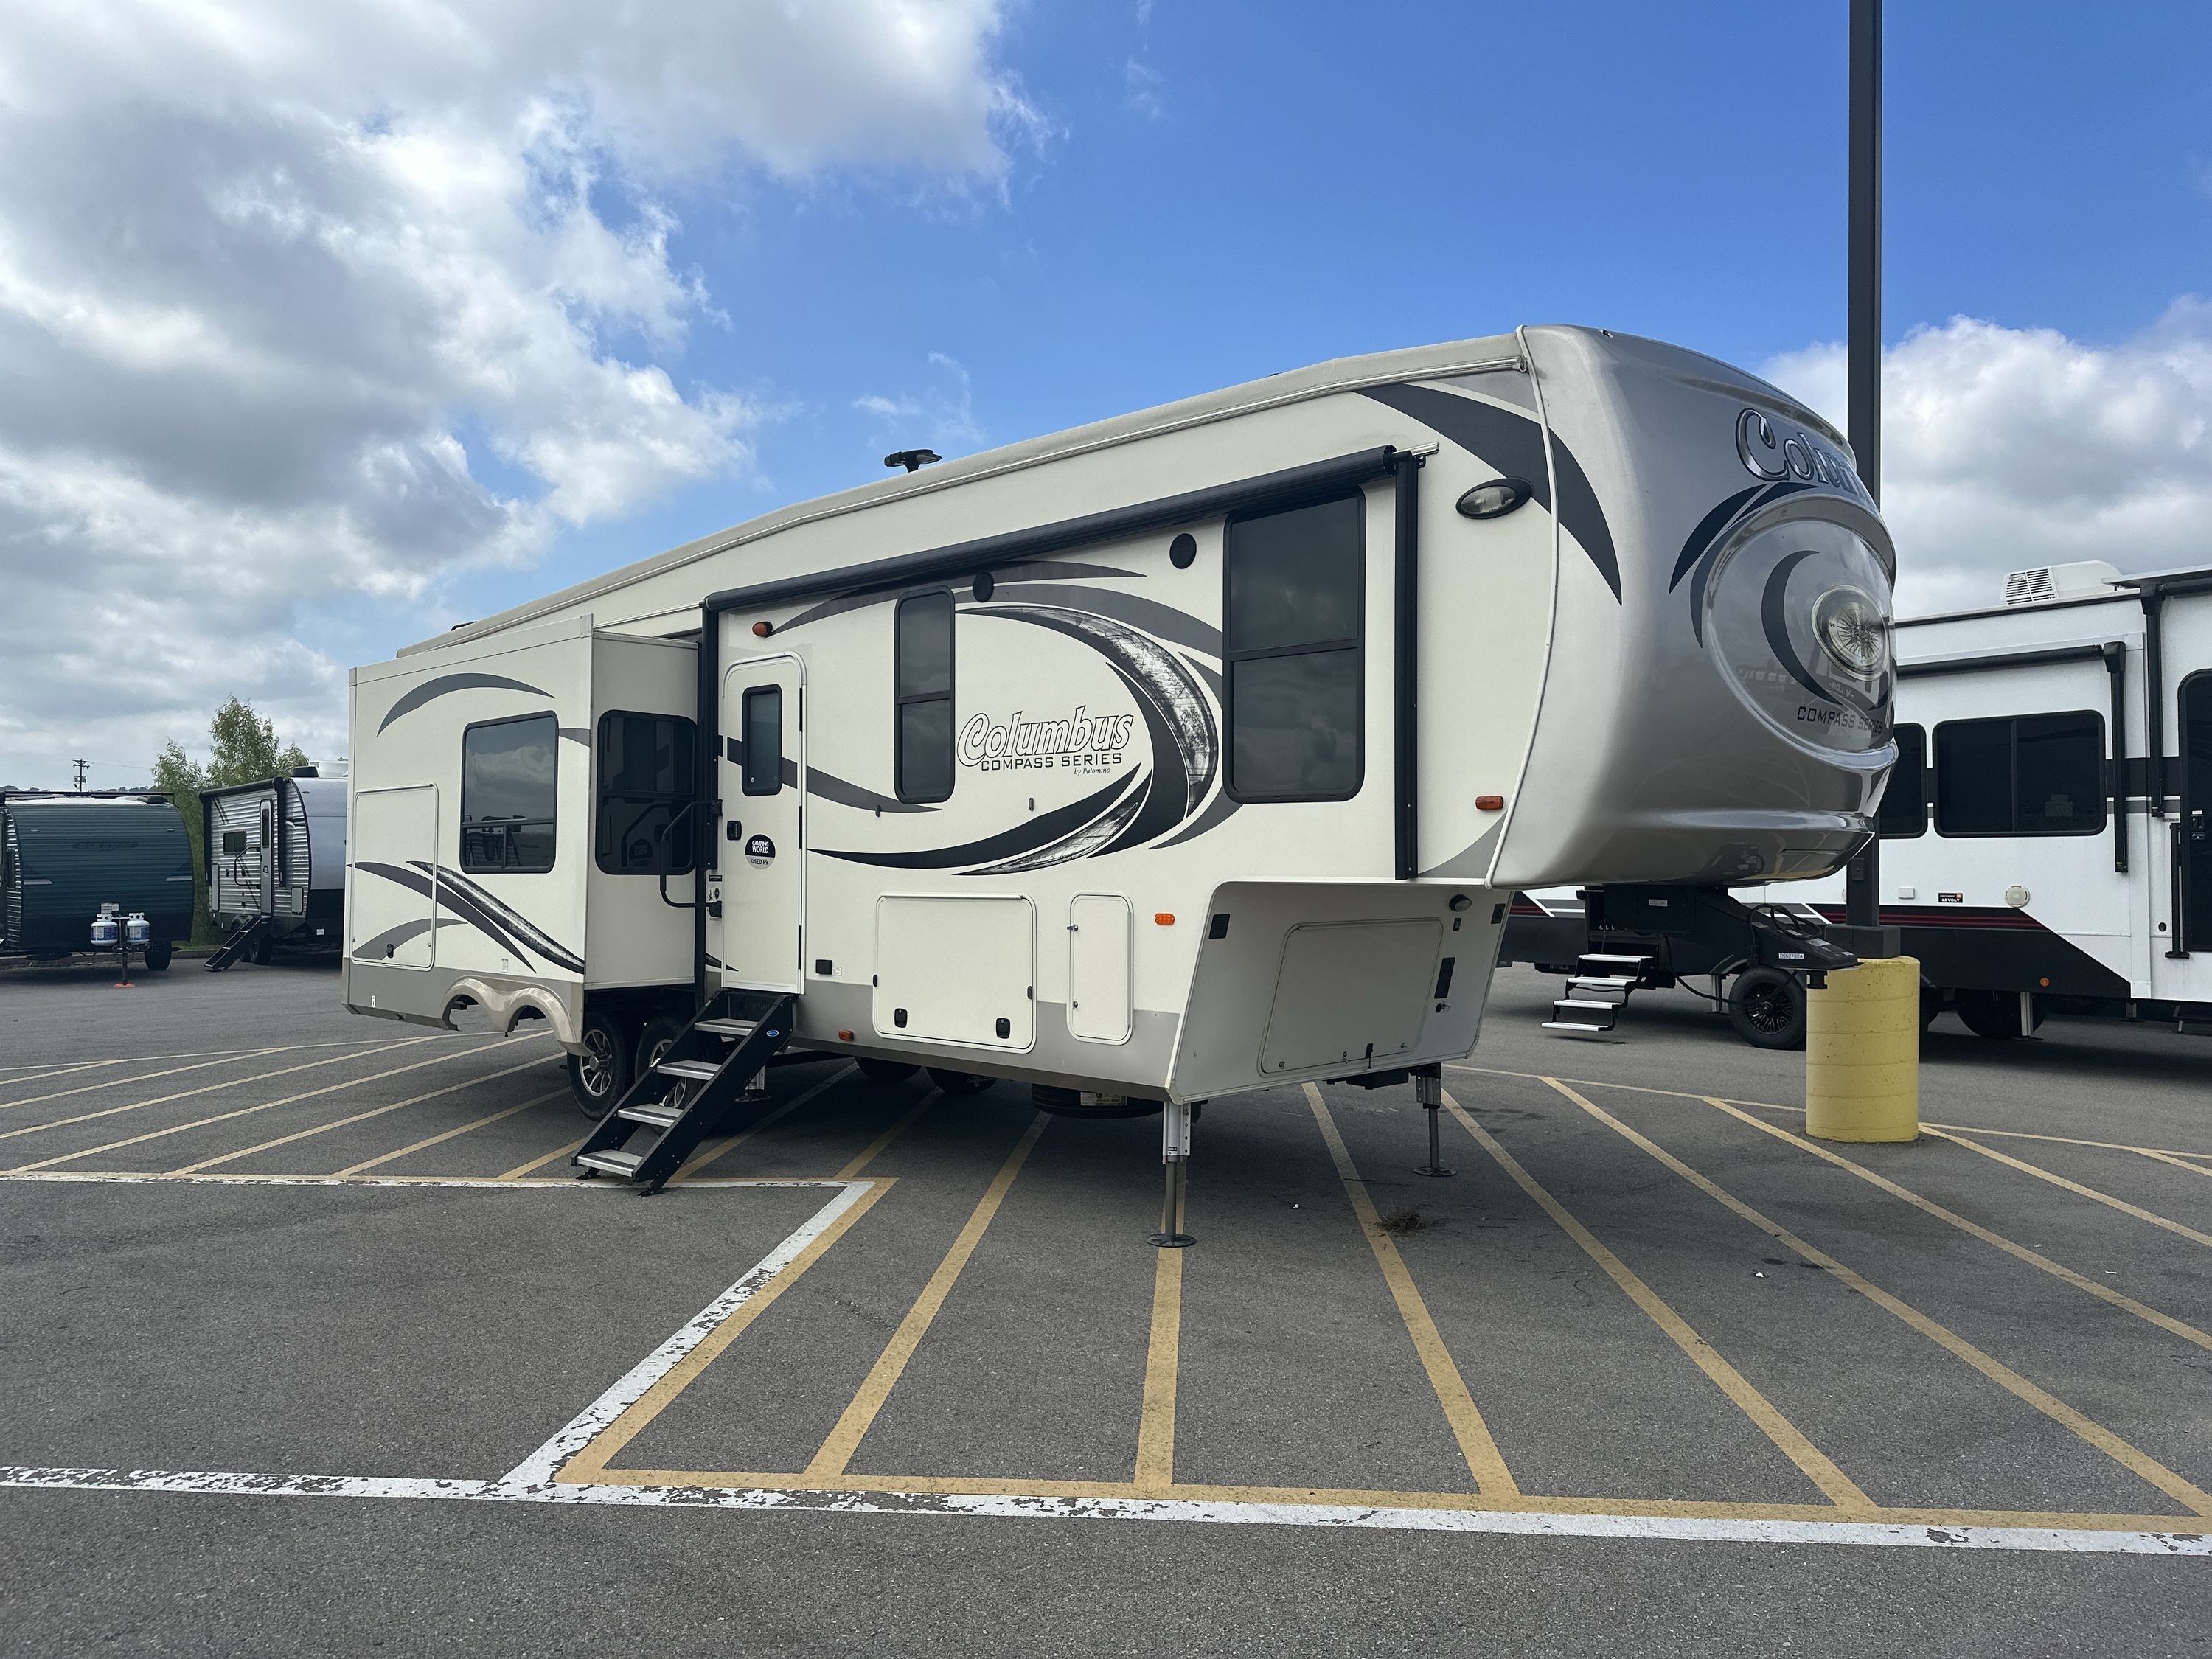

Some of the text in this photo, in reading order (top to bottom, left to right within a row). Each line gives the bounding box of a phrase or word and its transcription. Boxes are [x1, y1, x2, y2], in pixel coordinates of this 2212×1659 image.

[1797, 706, 1883, 734] COMPASS SERIES
[956, 704, 1134, 768] Columbus
[981, 752, 1122, 771] COMPASS SERIES
[1082, 767, 1110, 775] Palomino
